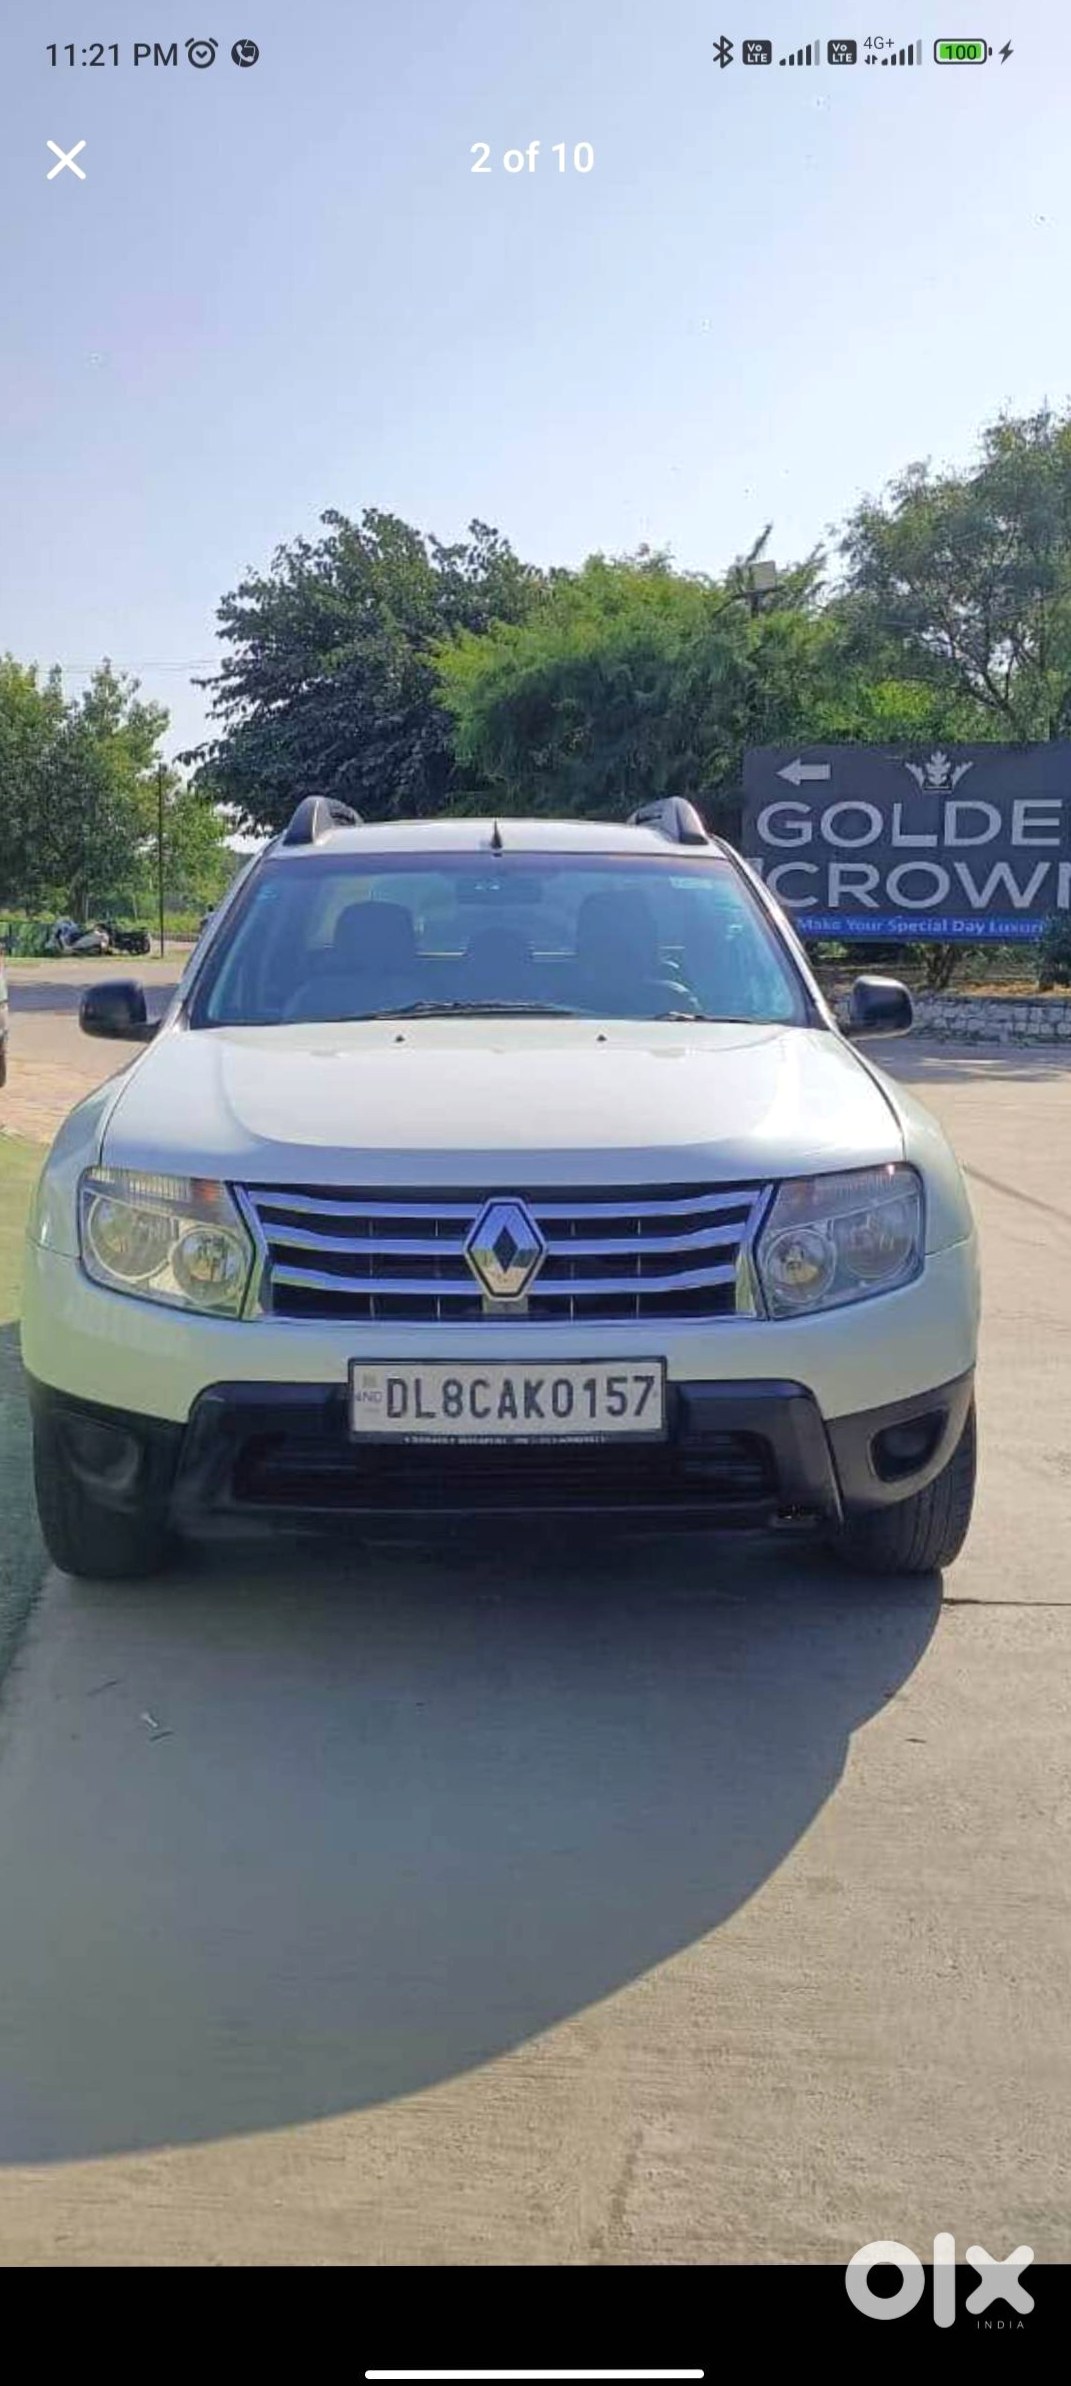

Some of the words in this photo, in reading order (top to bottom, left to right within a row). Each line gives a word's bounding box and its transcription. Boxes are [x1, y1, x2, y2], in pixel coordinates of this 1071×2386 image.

[756, 798, 1063, 848] GOLDE
[798, 918, 842, 932] Make
[847, 918, 882, 932] Your
[887, 917, 948, 934] Special
[952, 919, 985, 934] Day
[386, 1375, 656, 1420] DL8CAK0157
